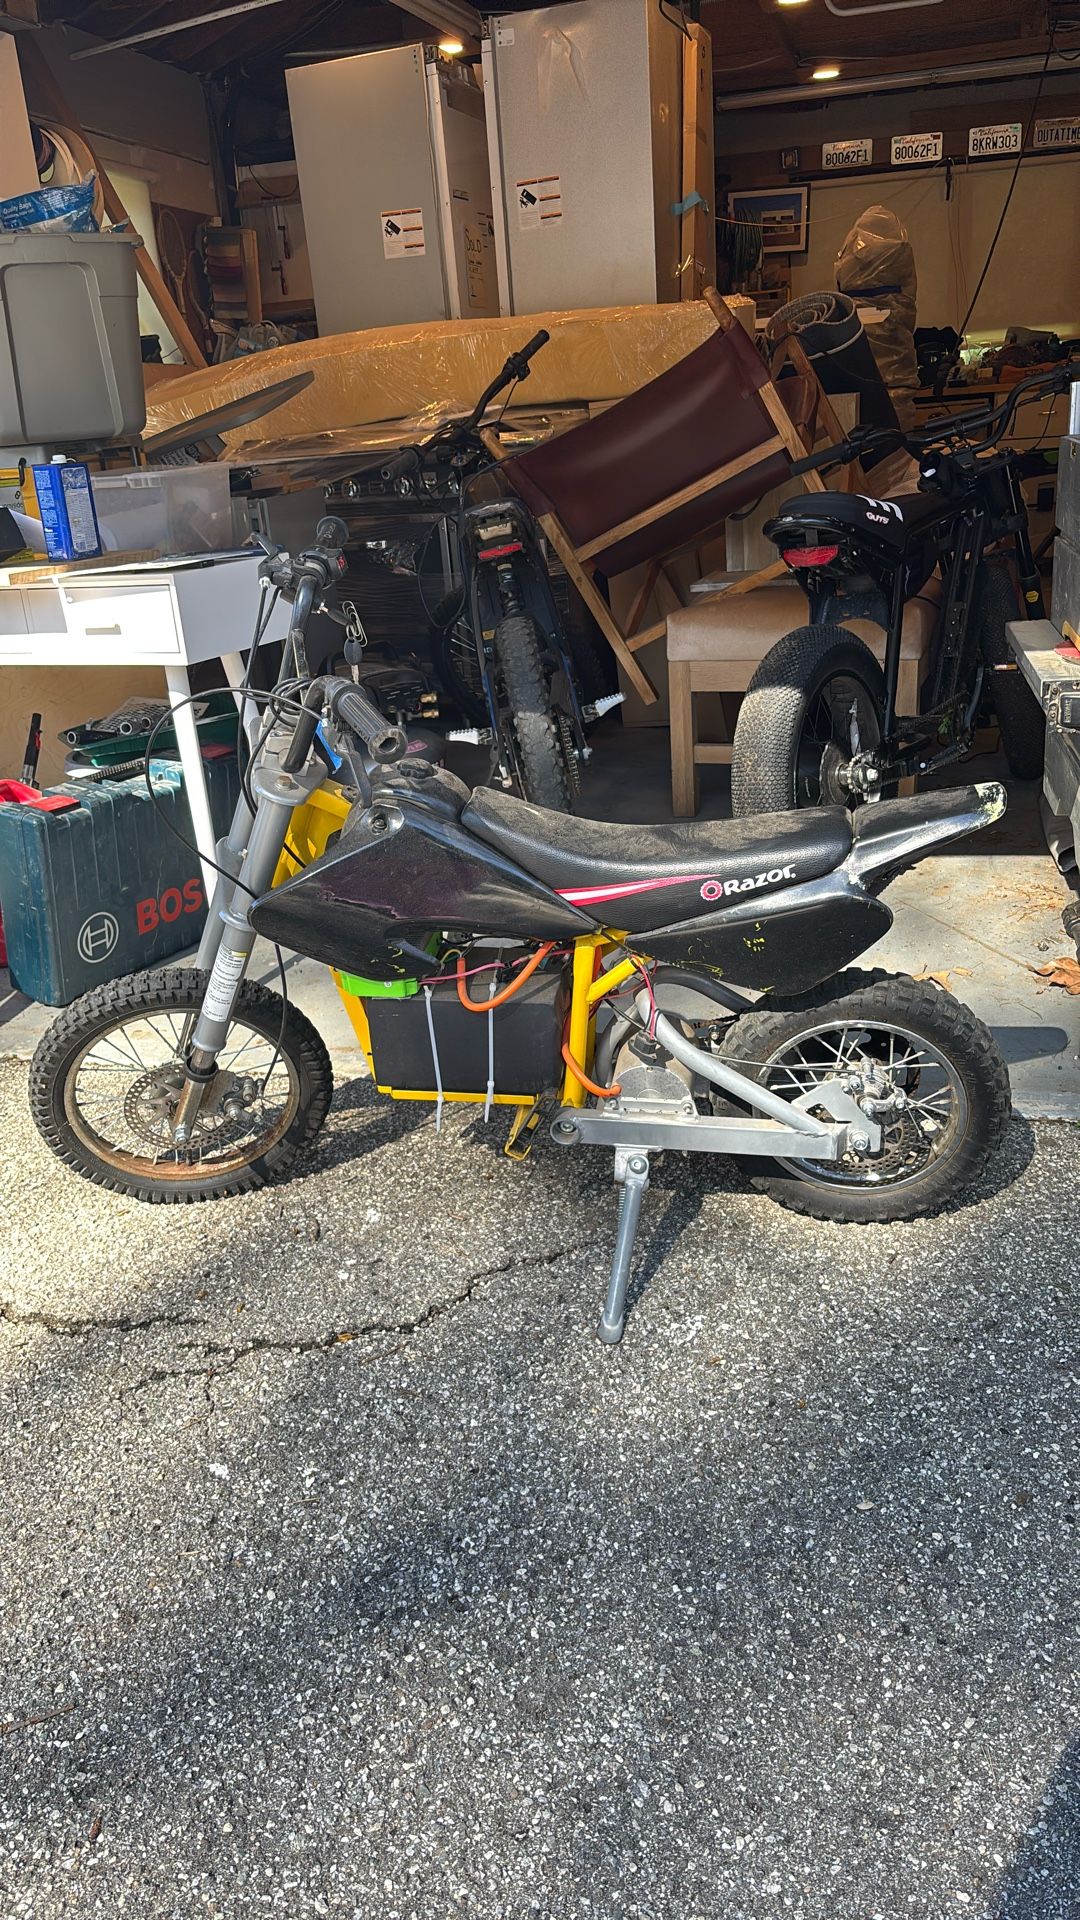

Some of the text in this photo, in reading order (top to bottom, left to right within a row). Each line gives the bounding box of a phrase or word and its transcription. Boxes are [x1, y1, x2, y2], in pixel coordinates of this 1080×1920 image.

[894, 143, 938, 160] 80062F1
[972, 134, 1018, 152] 8KRW303
[825, 149, 868, 166] 80062F1
[866, 512, 889, 524] GUTS
[136, 879, 205, 935] BOS
